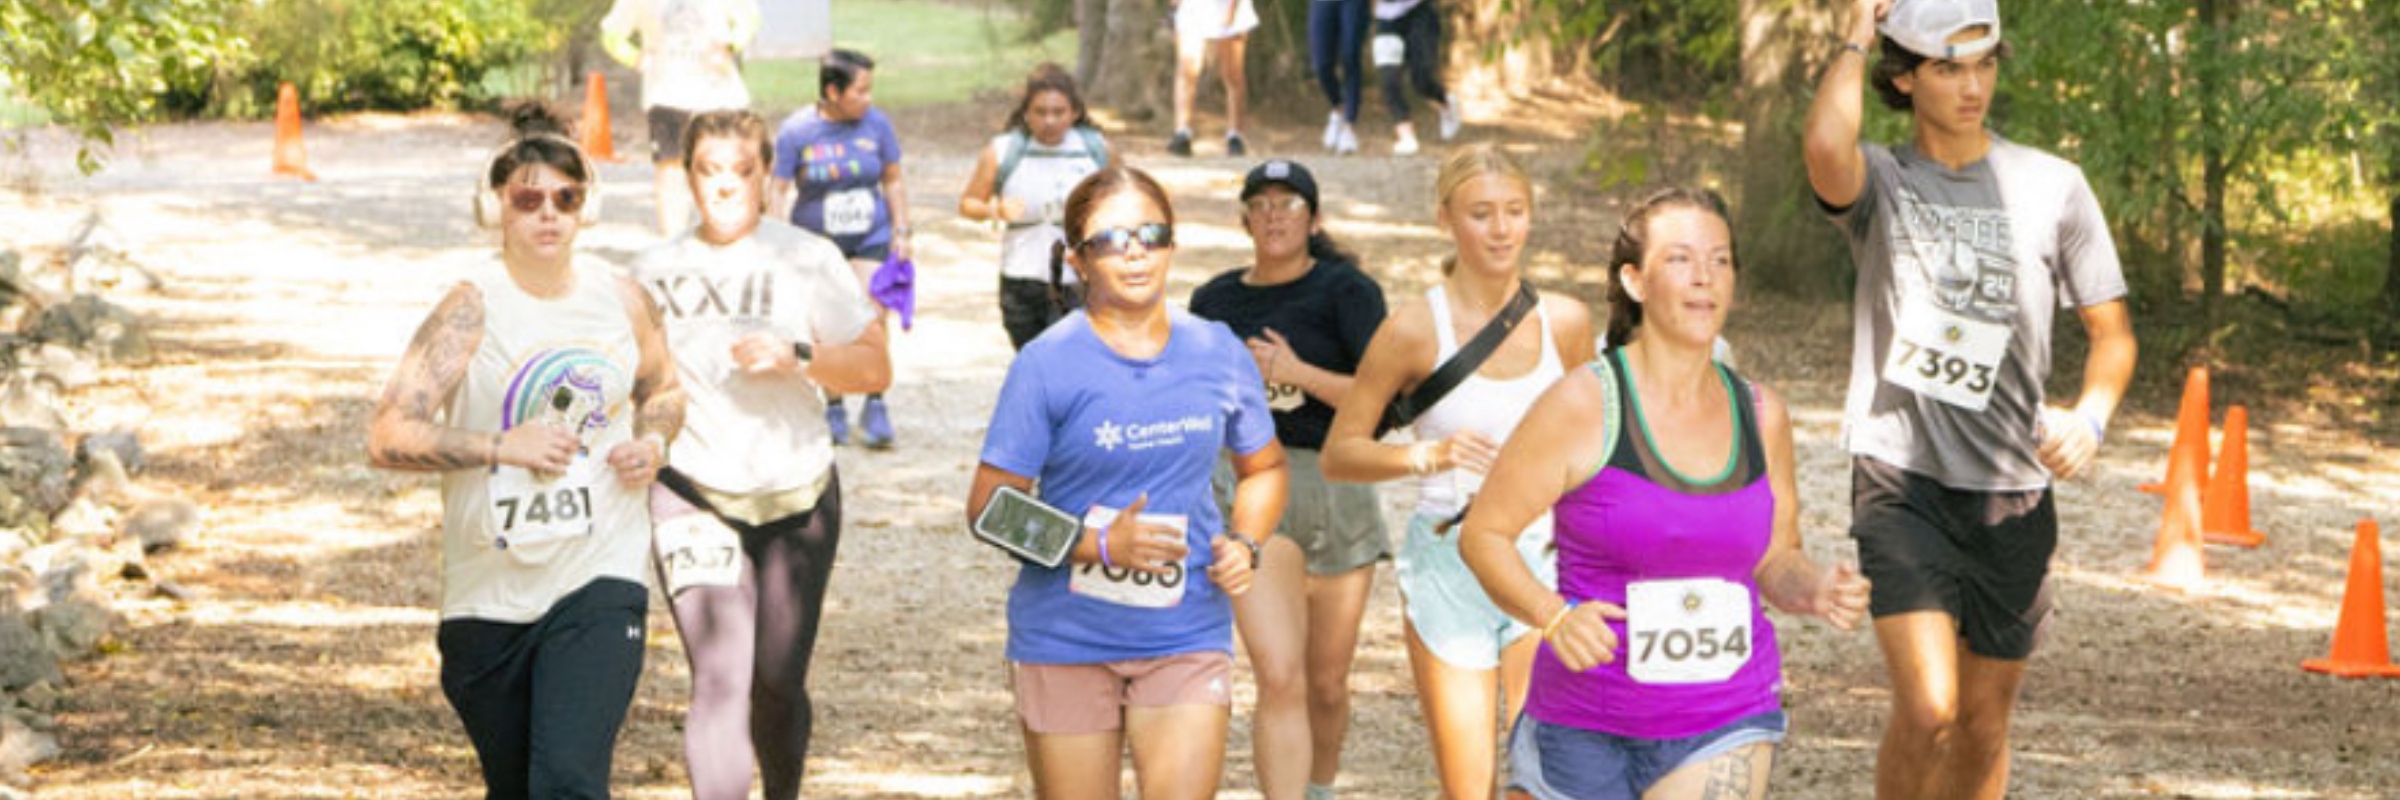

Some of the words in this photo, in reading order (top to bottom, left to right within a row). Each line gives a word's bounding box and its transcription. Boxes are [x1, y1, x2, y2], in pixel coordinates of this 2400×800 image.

[1982, 270, 2014, 300] 24
[1898, 339, 1993, 394] 7393
[495, 486, 592, 531] 7481
[1635, 625, 1748, 663] 7054
